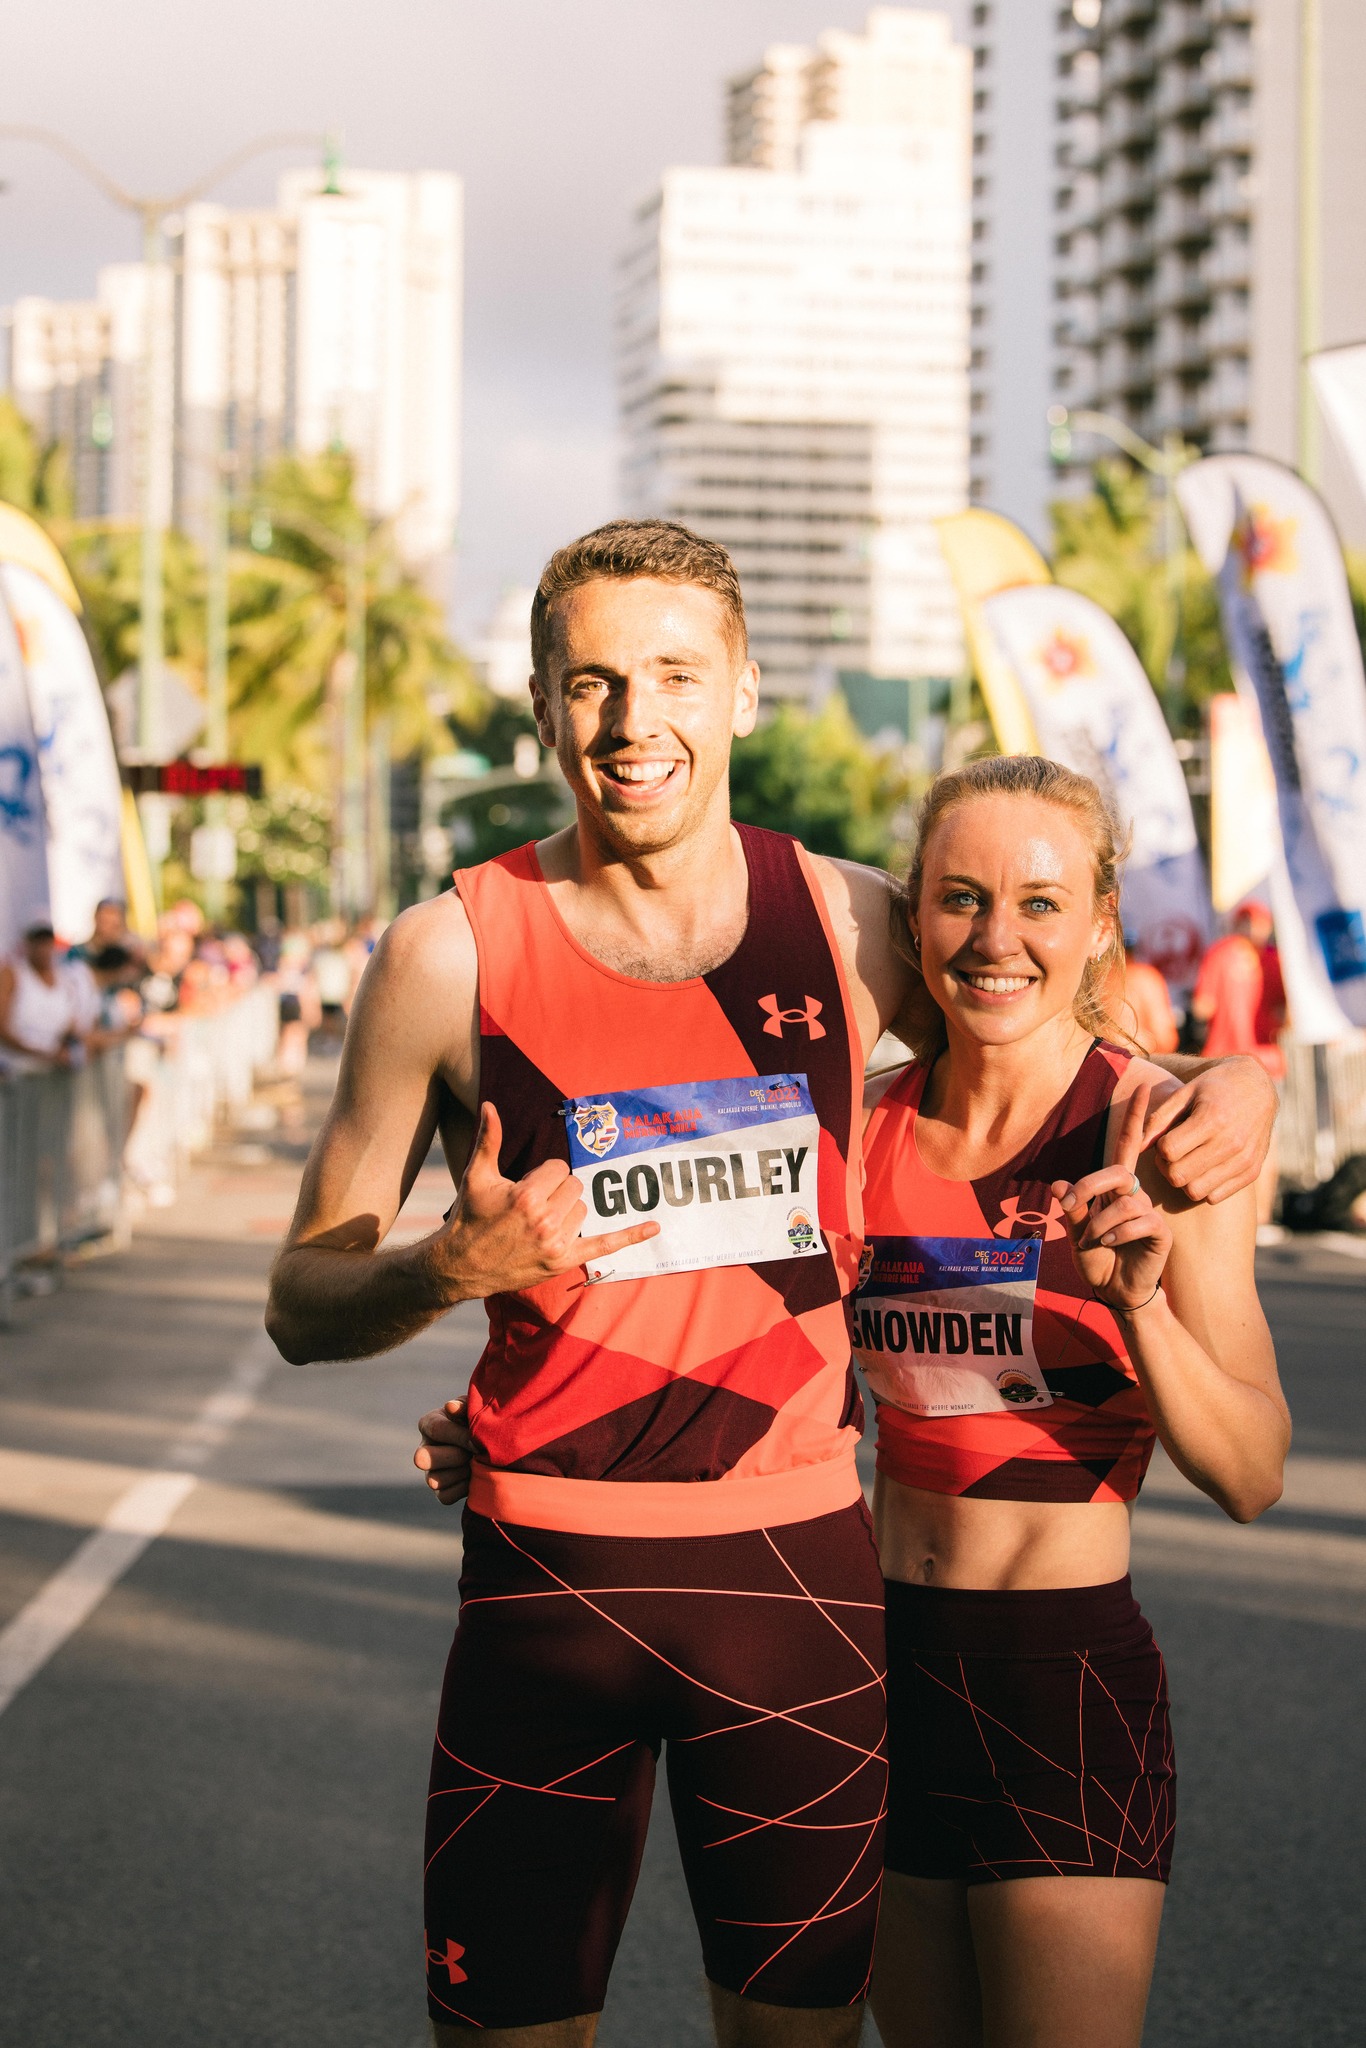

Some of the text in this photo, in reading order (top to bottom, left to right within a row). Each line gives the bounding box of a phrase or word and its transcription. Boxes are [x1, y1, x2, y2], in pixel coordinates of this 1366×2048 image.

[749, 1089, 765, 1097] DEC
[765, 1087, 801, 1103] 2022
[621, 1107, 703, 1129] KALAKAUA
[623, 1121, 698, 1140] MERRIE MILE
[592, 1147, 809, 1218] GOURLEY
[974, 1250, 990, 1258] DEC
[981, 1257, 989, 1265] 10
[990, 1251, 1026, 1266] 2022
[873, 1260, 925, 1274] KALAKAUA
[900, 1273, 920, 1284] MILE
